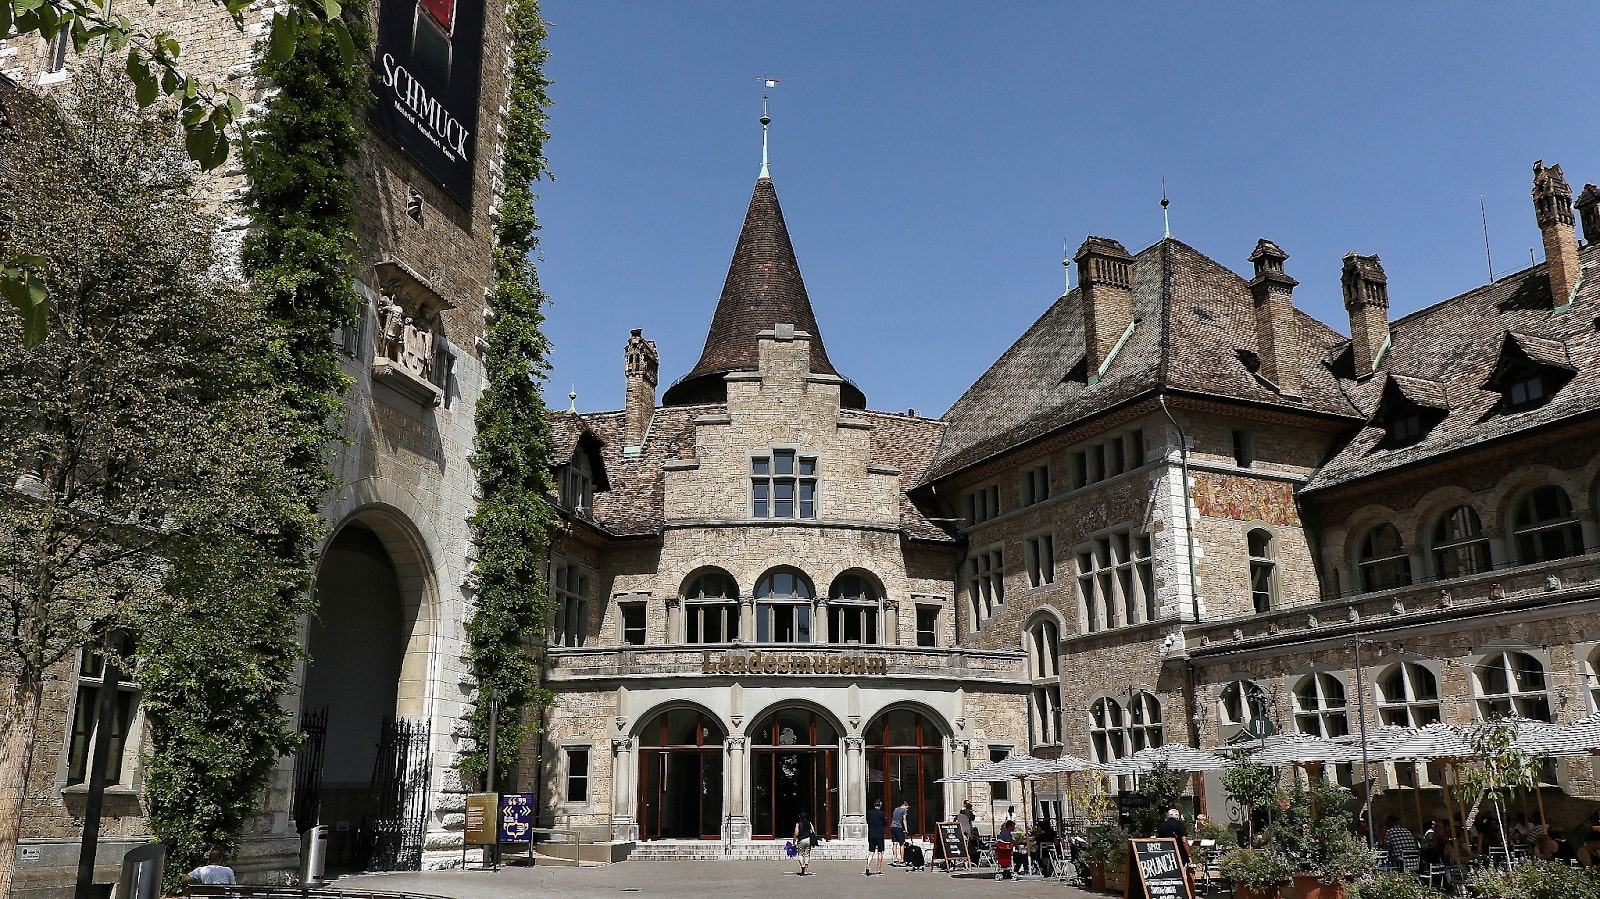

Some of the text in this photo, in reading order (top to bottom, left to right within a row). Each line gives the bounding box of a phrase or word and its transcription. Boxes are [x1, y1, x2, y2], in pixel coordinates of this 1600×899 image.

[382, 52, 470, 162] SCHMUCK
[702, 650, 887, 675] Landesmuseum
[1140, 853, 1178, 879] BRUNCH
